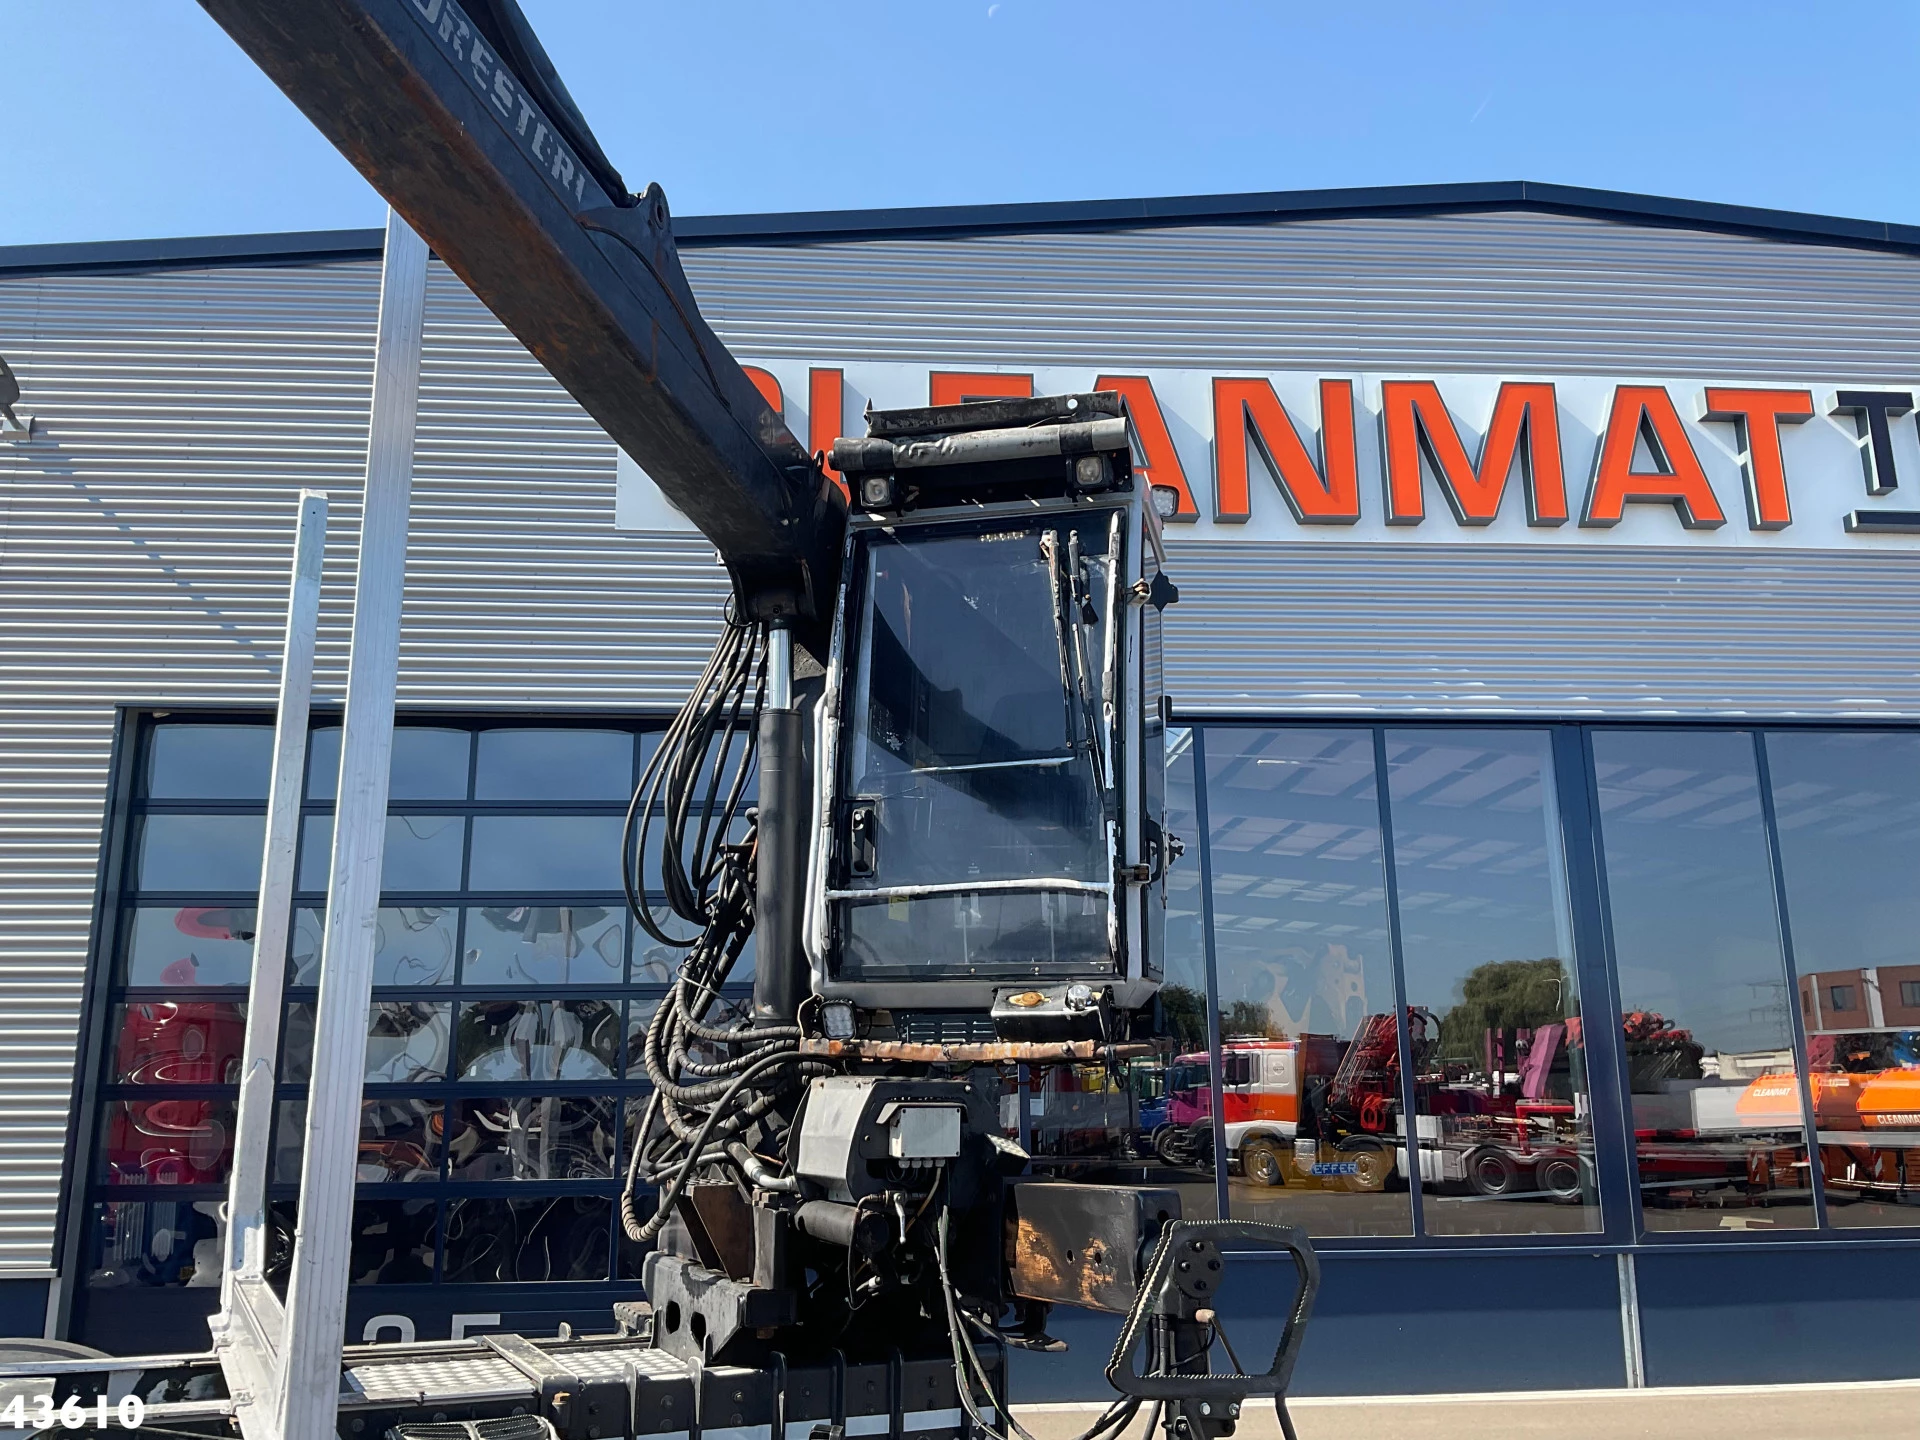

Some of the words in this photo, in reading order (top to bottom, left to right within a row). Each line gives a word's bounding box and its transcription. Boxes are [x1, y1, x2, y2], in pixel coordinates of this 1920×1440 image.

[740, 364, 1815, 531] LANMAT
[1752, 1087, 1792, 1097] CLEANMAT
[1876, 1114, 1920, 1125] CLEANMA
[1314, 1163, 1357, 1174] EFFER
